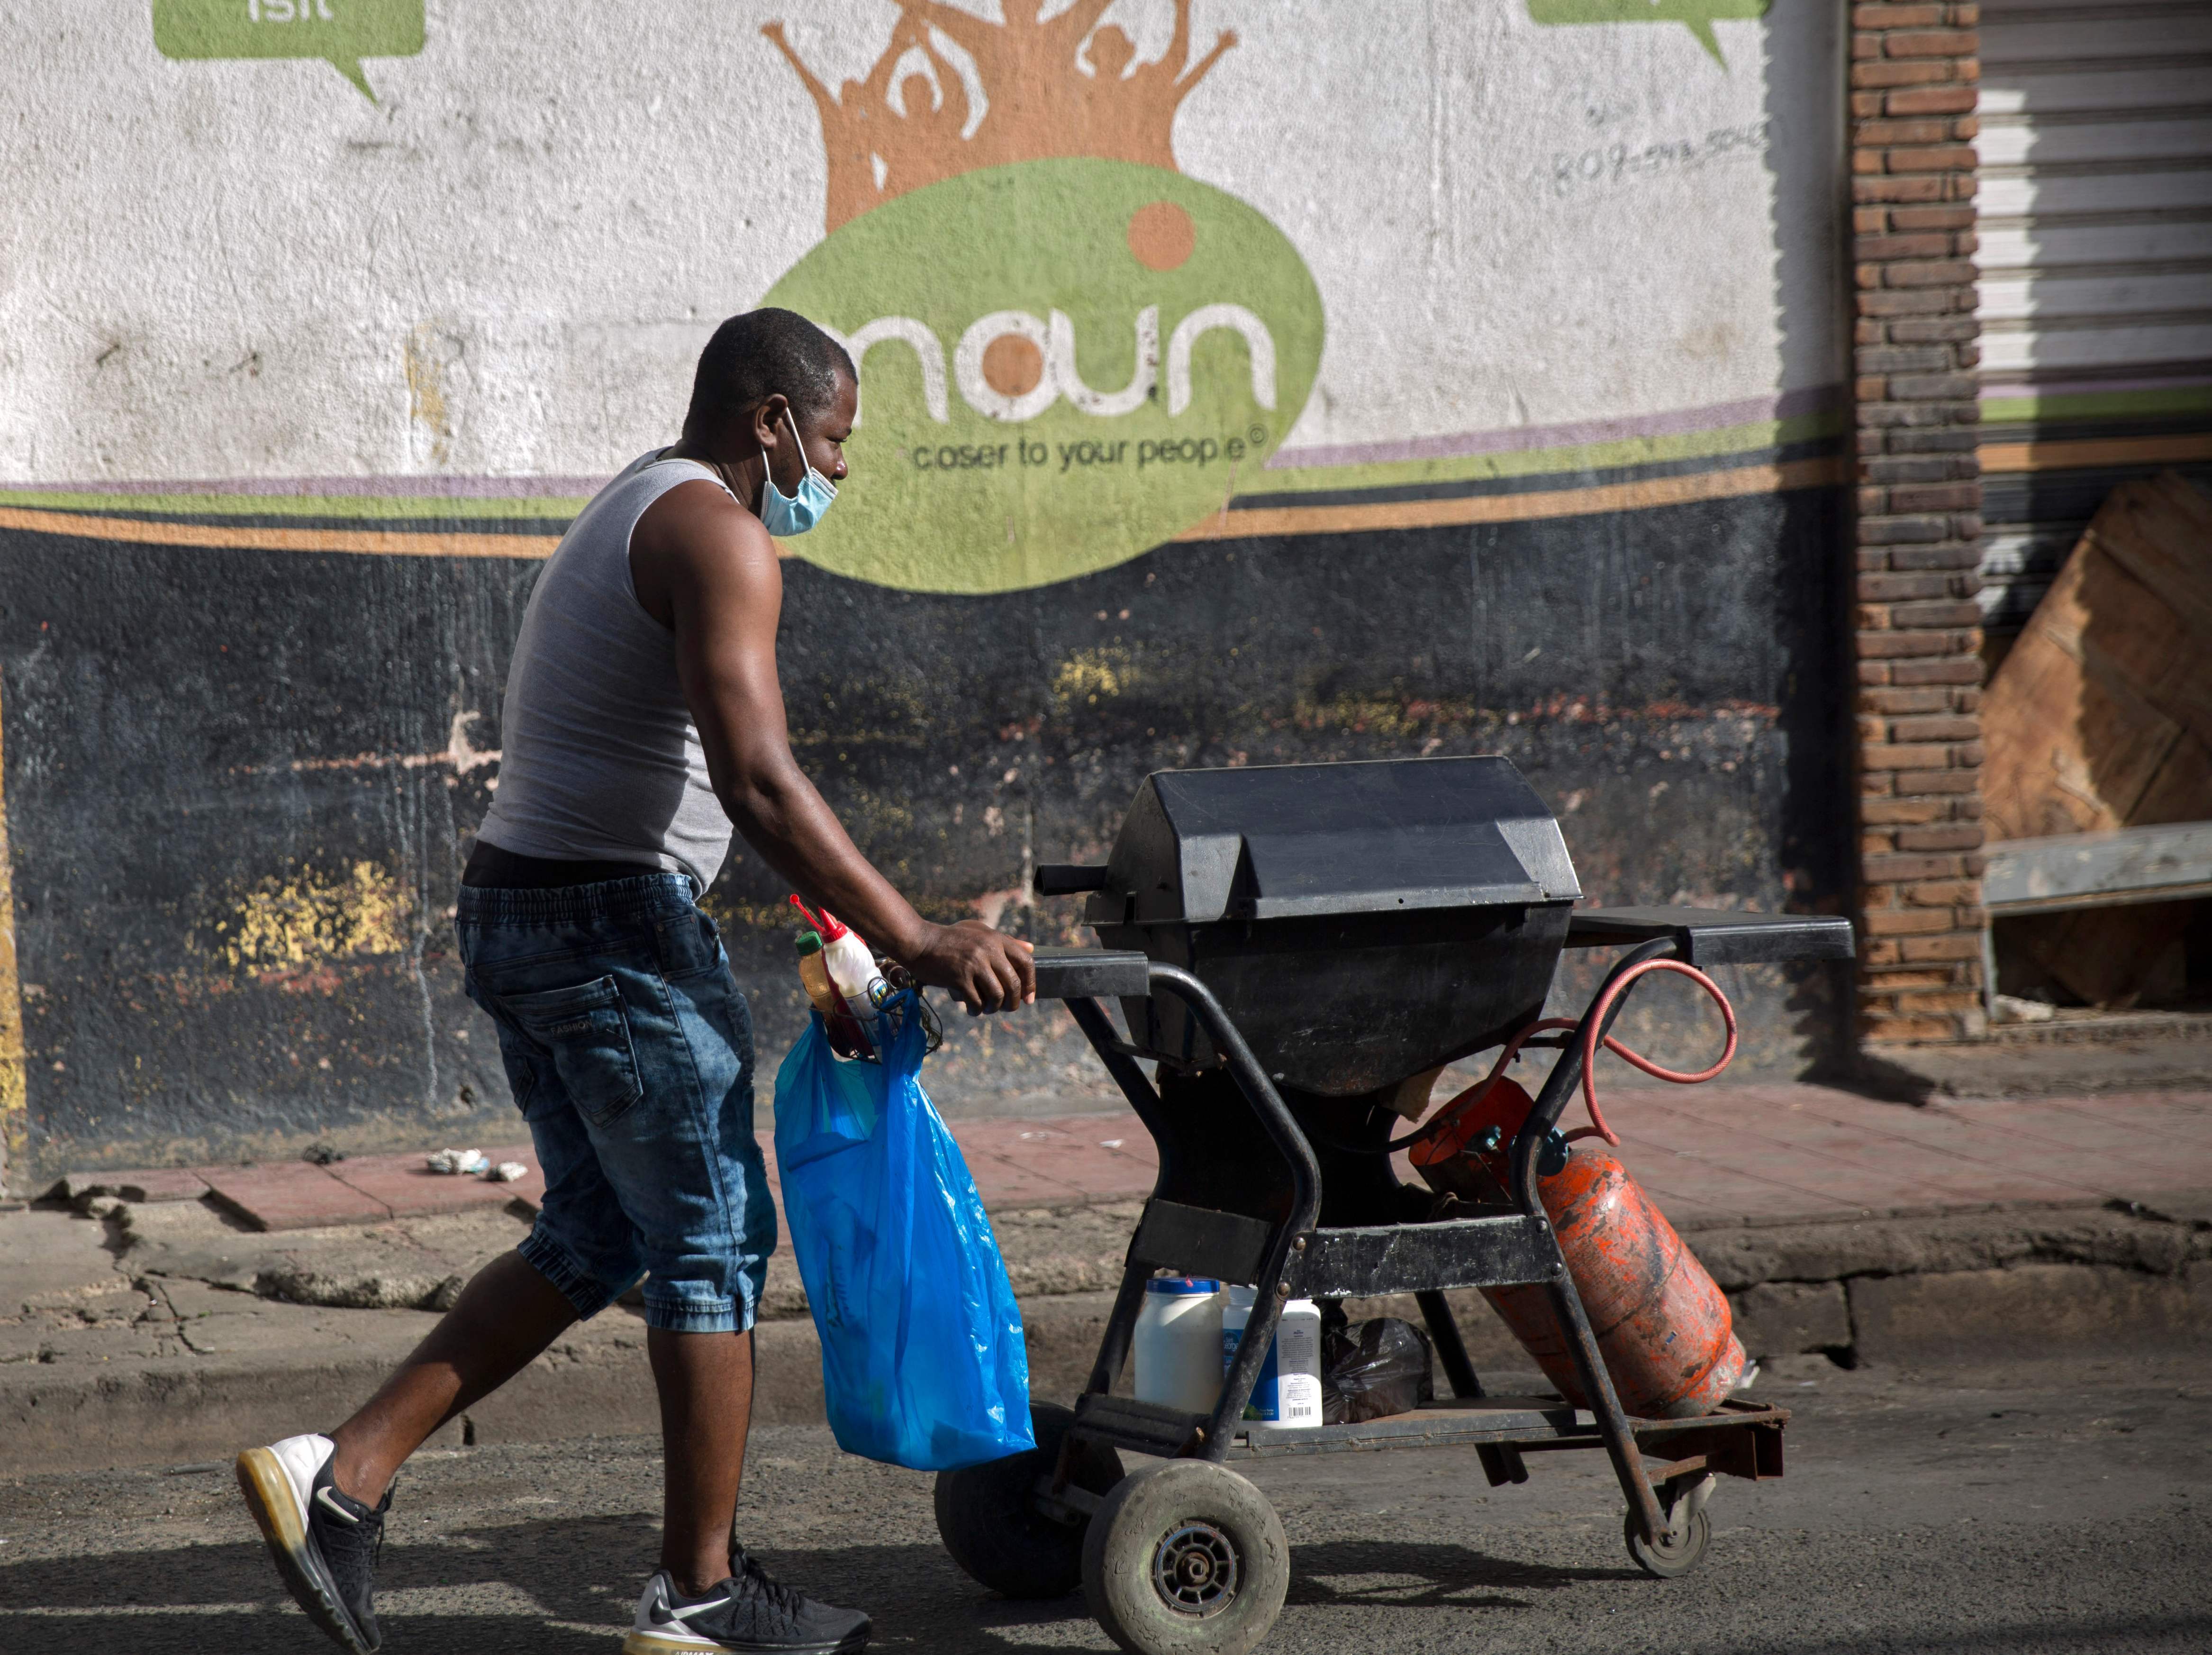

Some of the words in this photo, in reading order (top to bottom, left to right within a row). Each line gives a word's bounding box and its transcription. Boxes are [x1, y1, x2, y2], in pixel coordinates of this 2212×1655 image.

[1018, 436, 1049, 466] to
[1057, 439, 1128, 473] your
[550, 1018, 593, 1036] FASHION
